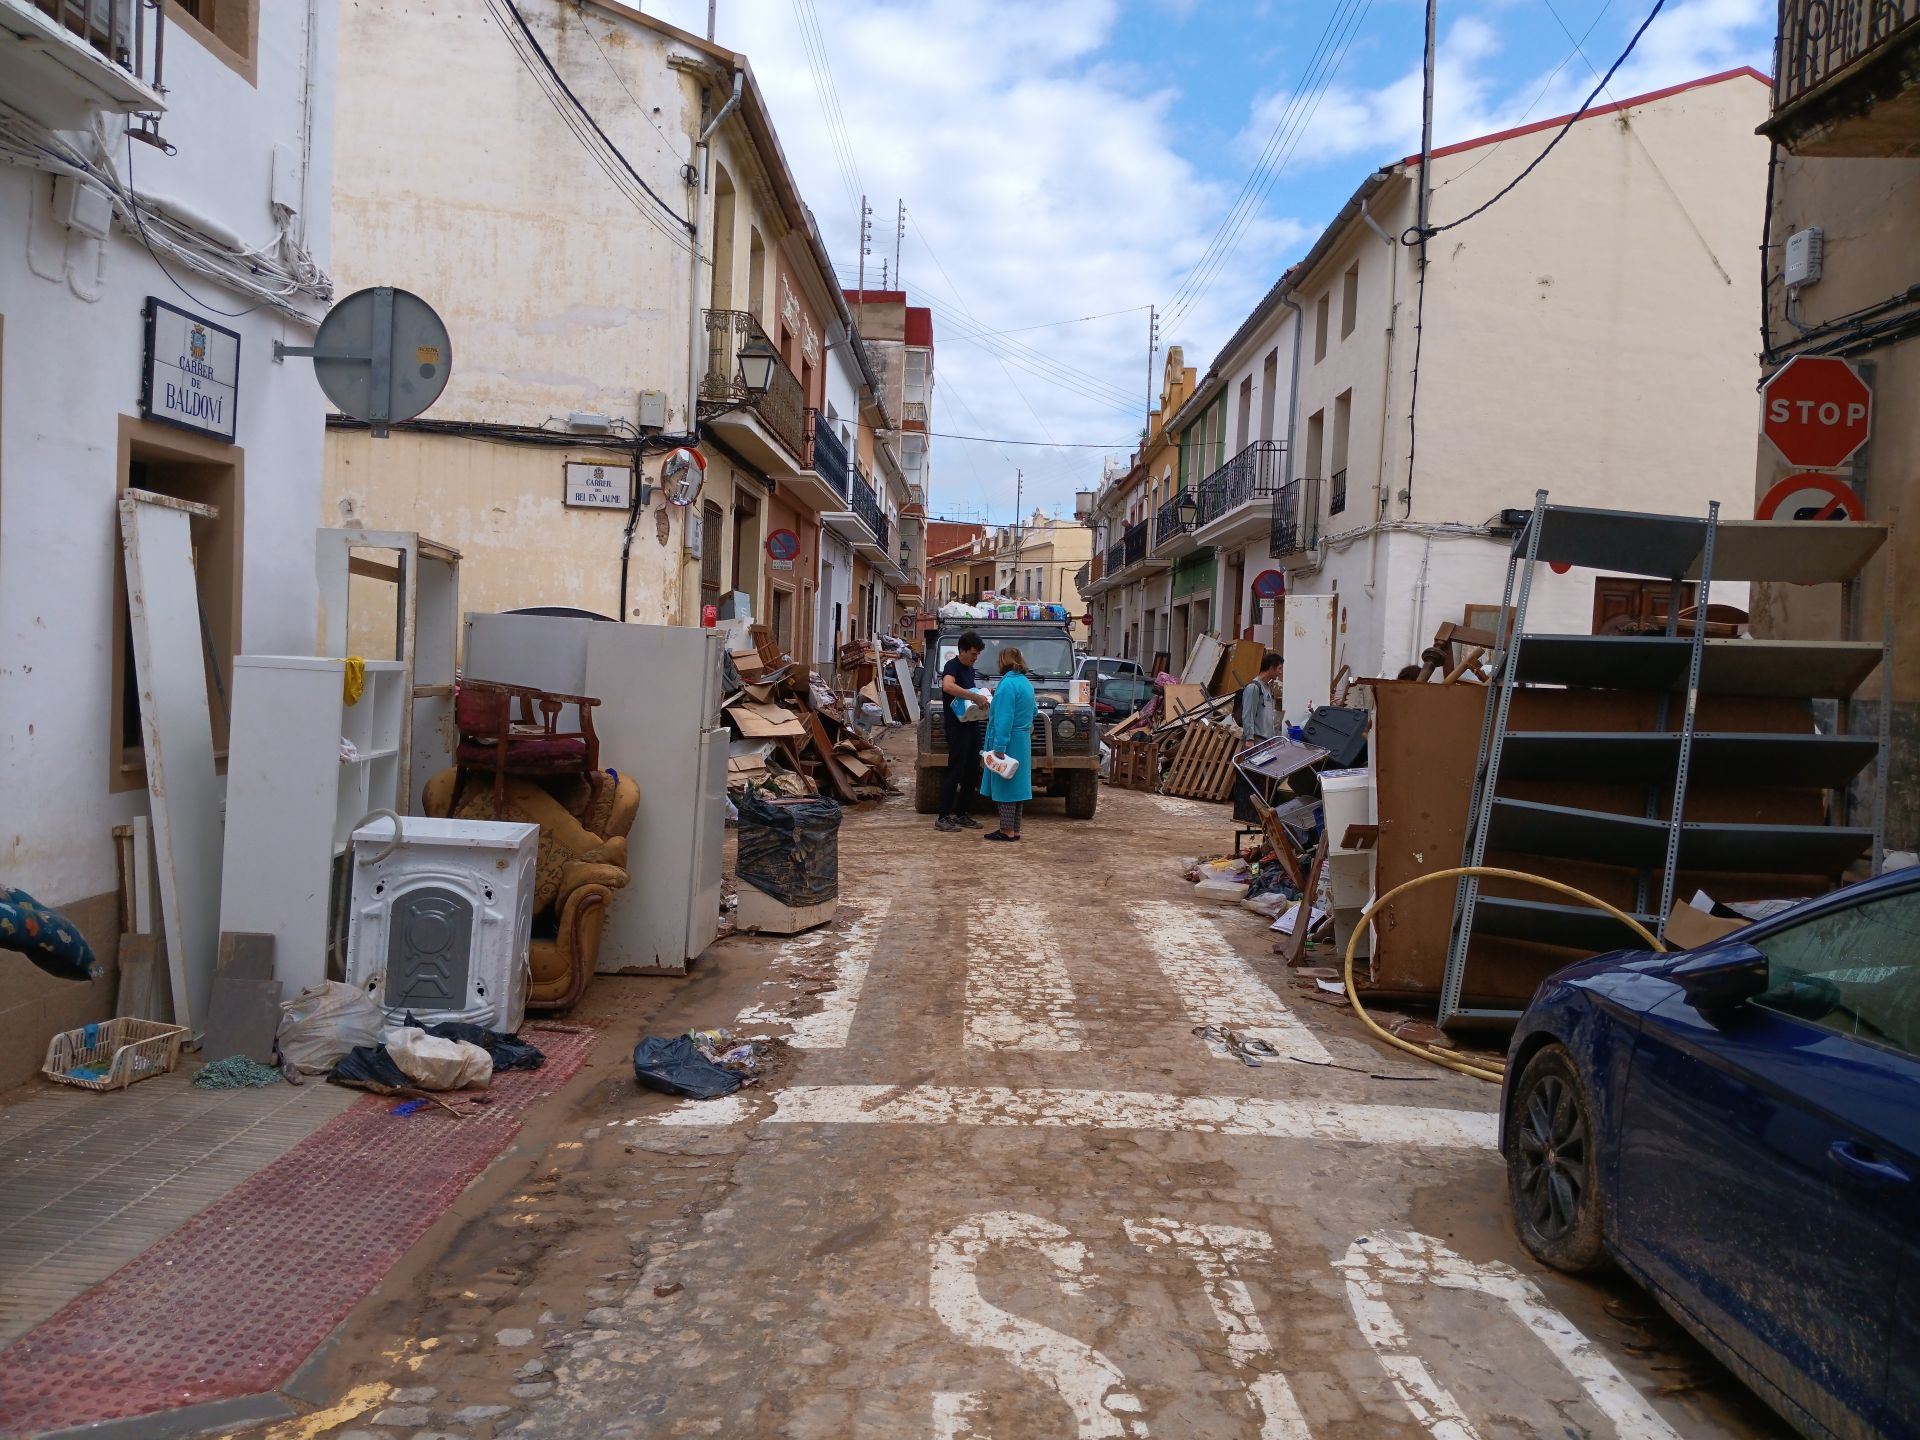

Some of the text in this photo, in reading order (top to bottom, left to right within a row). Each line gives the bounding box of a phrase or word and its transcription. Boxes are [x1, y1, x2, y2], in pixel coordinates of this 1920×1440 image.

[179, 356, 214, 380] CARRER
[191, 378, 201, 390] DE
[166, 383, 223, 424] BALDOVÍ
[1769, 399, 1866, 427] STOP
[586, 479, 611, 487] CARRER
[575, 493, 620, 503] REI EN JAUME
